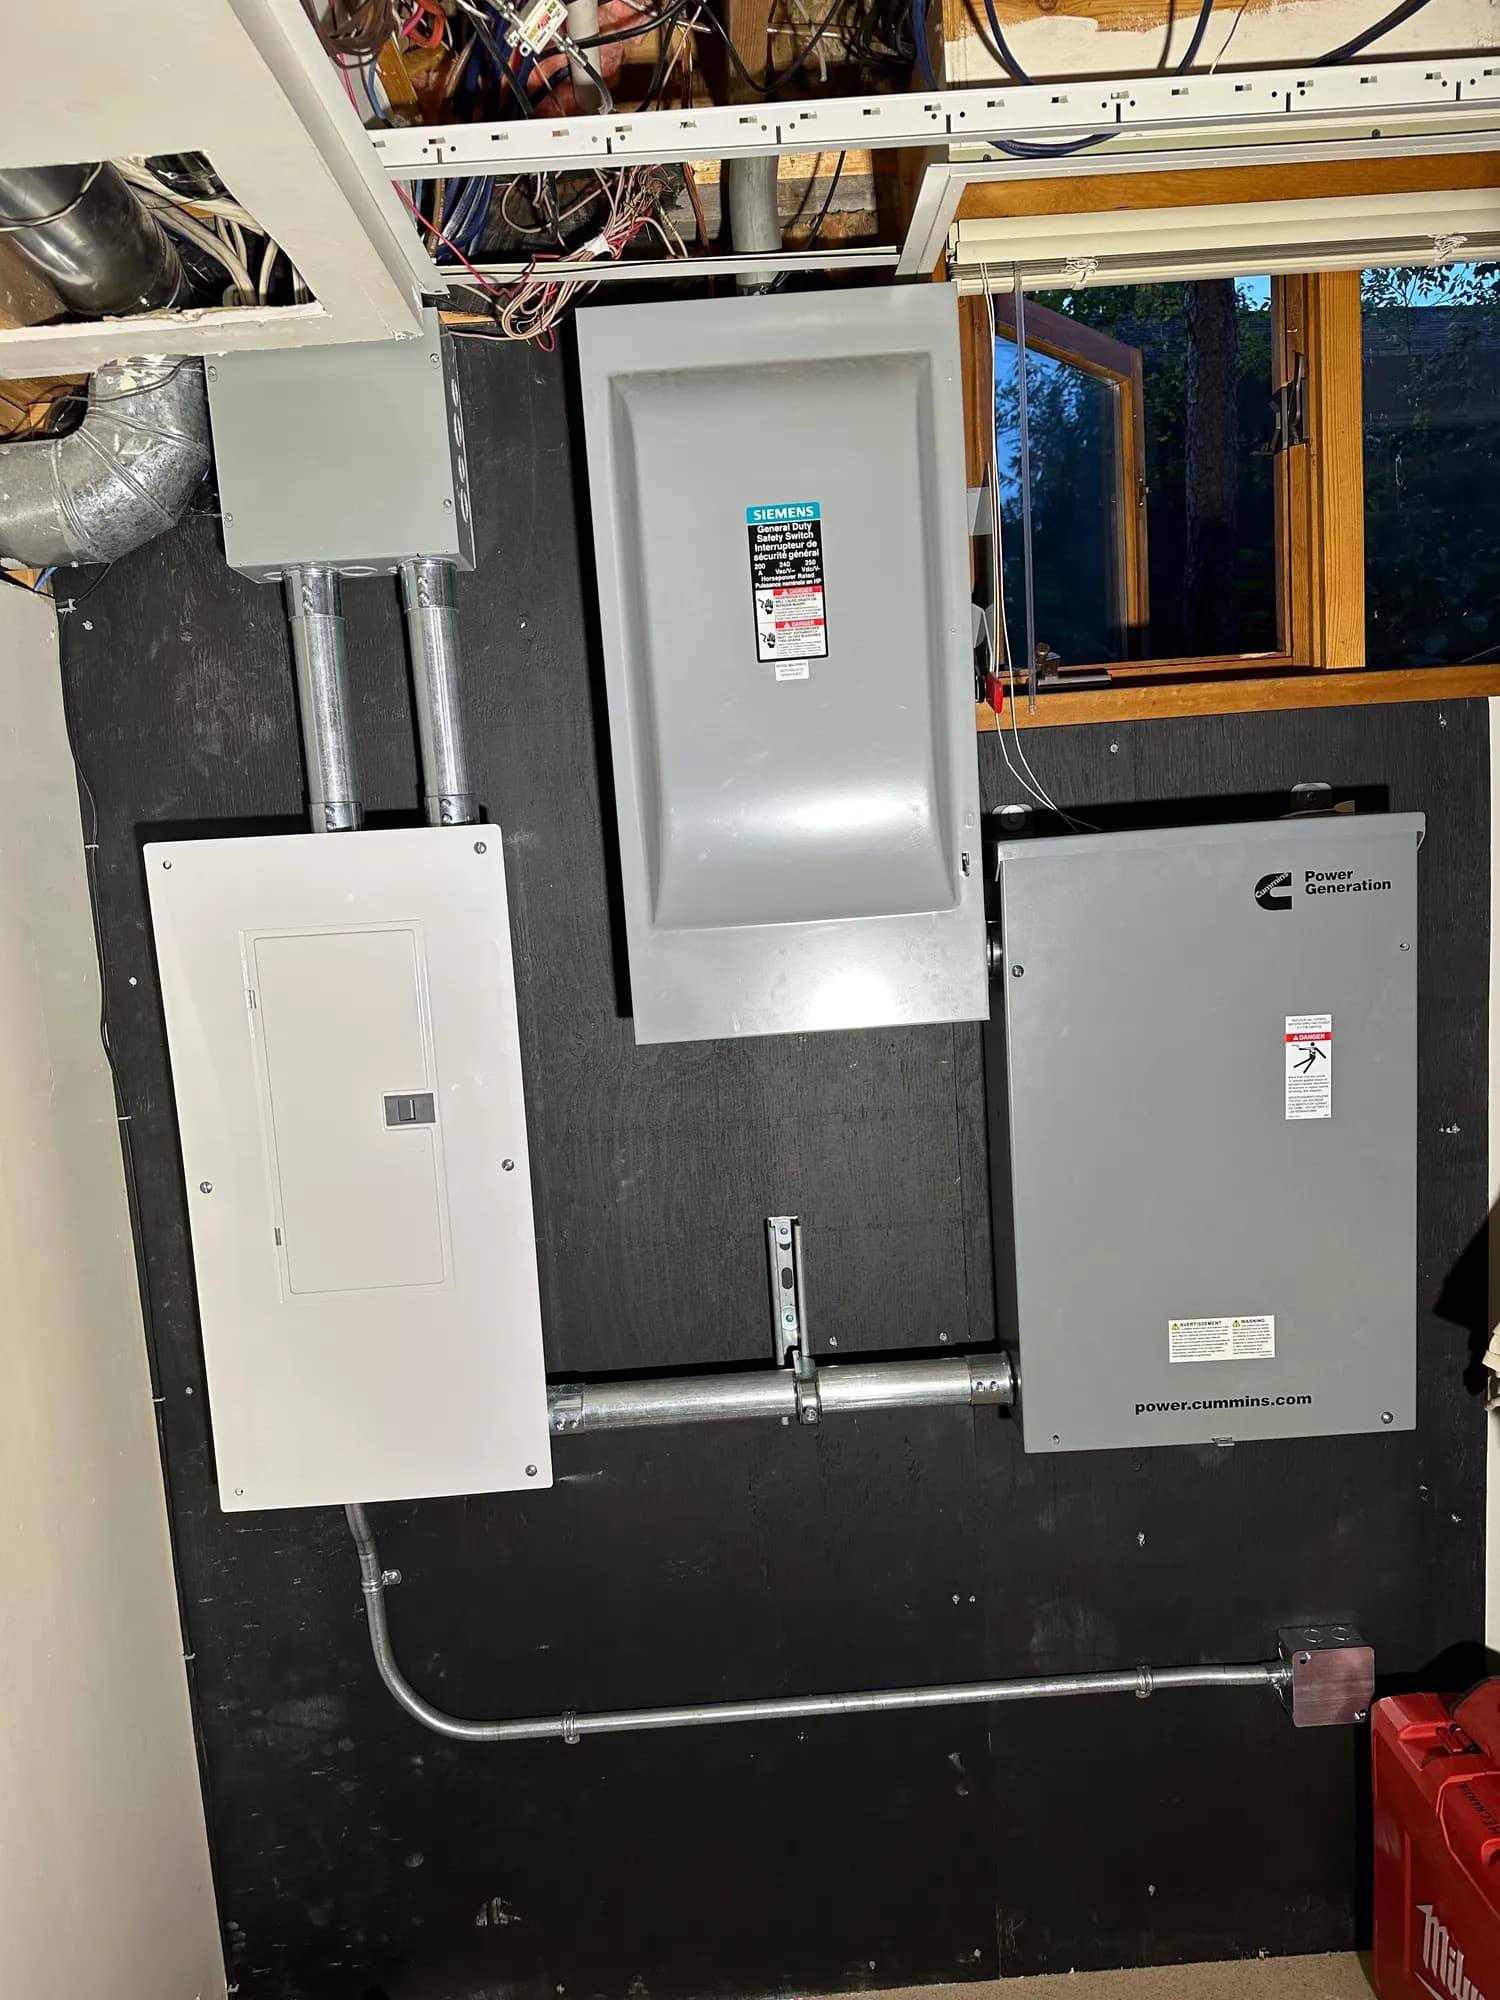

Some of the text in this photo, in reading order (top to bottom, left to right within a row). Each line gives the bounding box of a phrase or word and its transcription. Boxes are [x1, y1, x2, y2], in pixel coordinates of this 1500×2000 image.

[753, 506, 814, 521] SIEMENS
[757, 522, 812, 533] General Duty
[757, 531, 814, 543] Safety Switch
[754, 539, 818, 552] Interrupteur de
[753, 548, 820, 562] sécurité général
[761, 574, 796, 582] Horsepower
[1305, 869, 1353, 882] Power
[1305, 879, 1392, 895] Generation
[1298, 1033, 1326, 1041] DANGER
[1135, 1394, 1312, 1415] power.cummins.com
